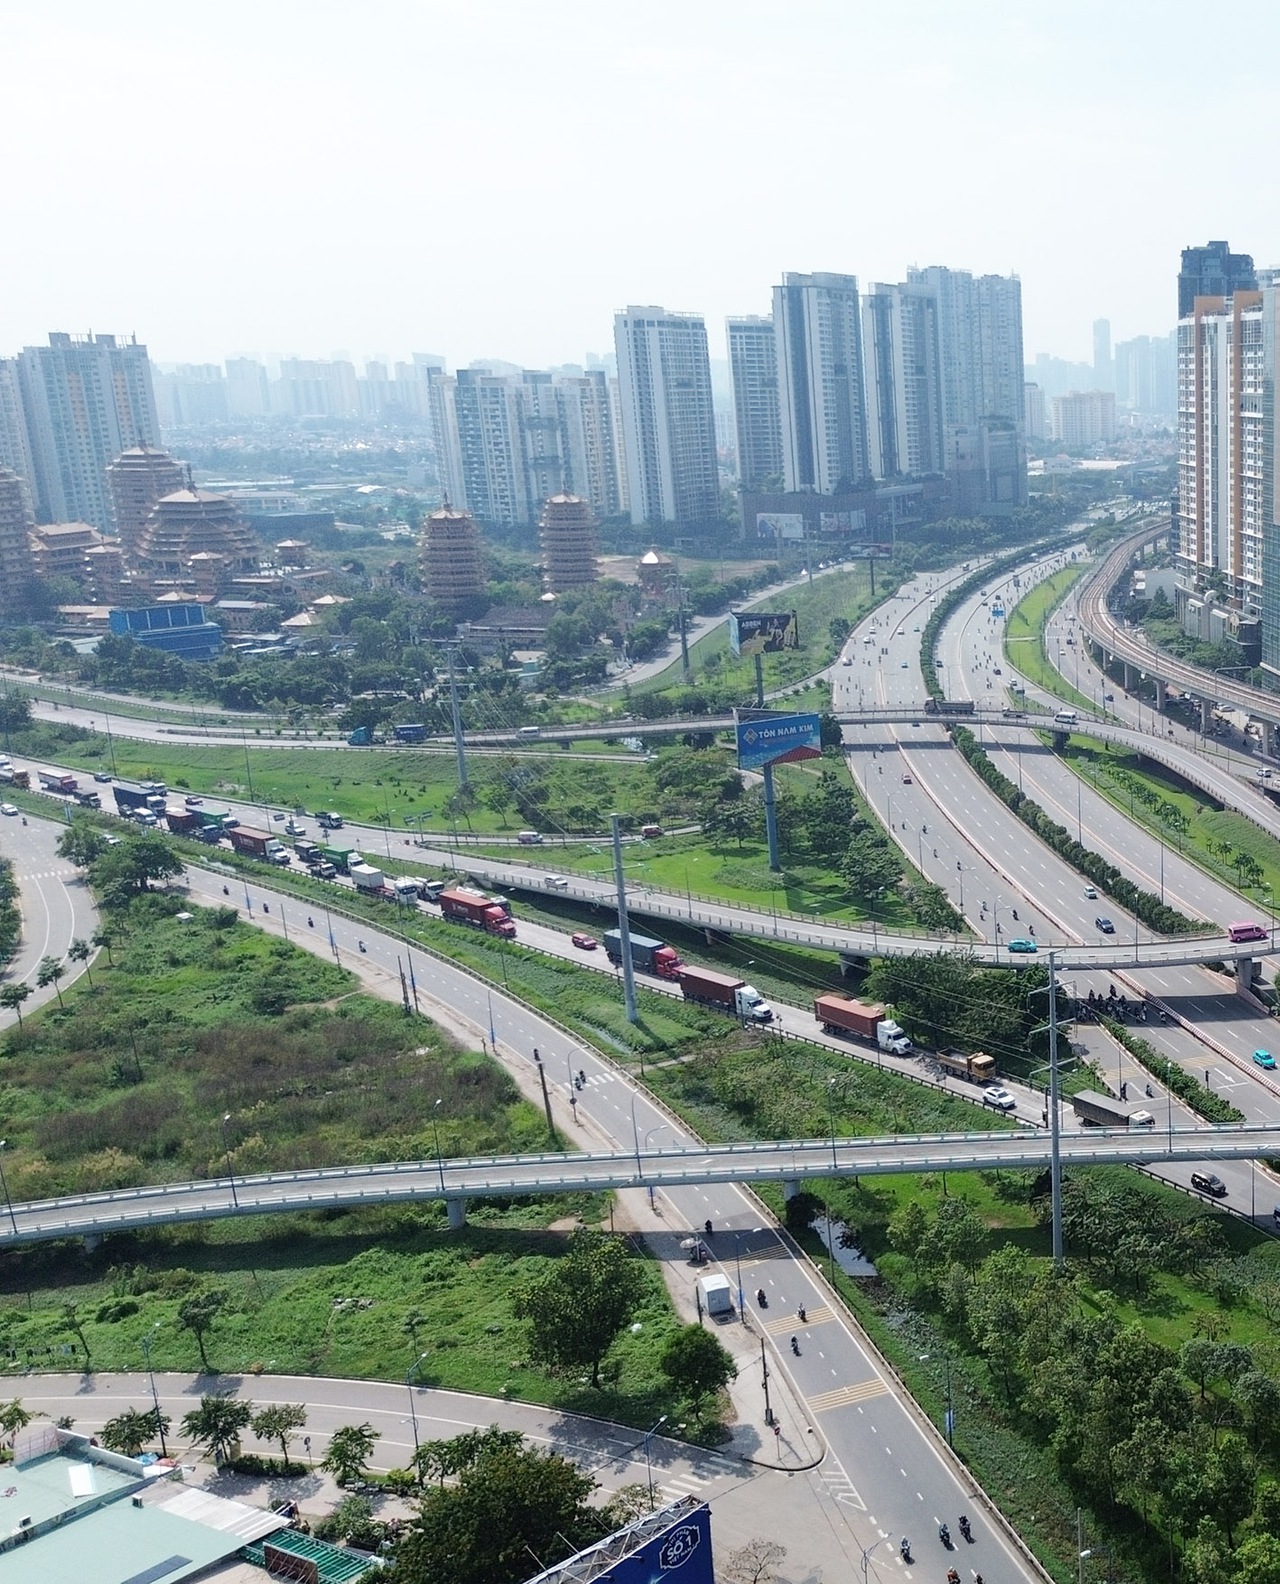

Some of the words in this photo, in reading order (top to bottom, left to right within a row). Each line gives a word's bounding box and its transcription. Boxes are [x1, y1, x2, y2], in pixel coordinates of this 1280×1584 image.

[758, 729, 775, 739] TÔN
[777, 727, 797, 736] NAM
[799, 724, 814, 732] KIM
[667, 1535, 684, 1560] SỐ
[686, 1534, 692, 1546] 1
